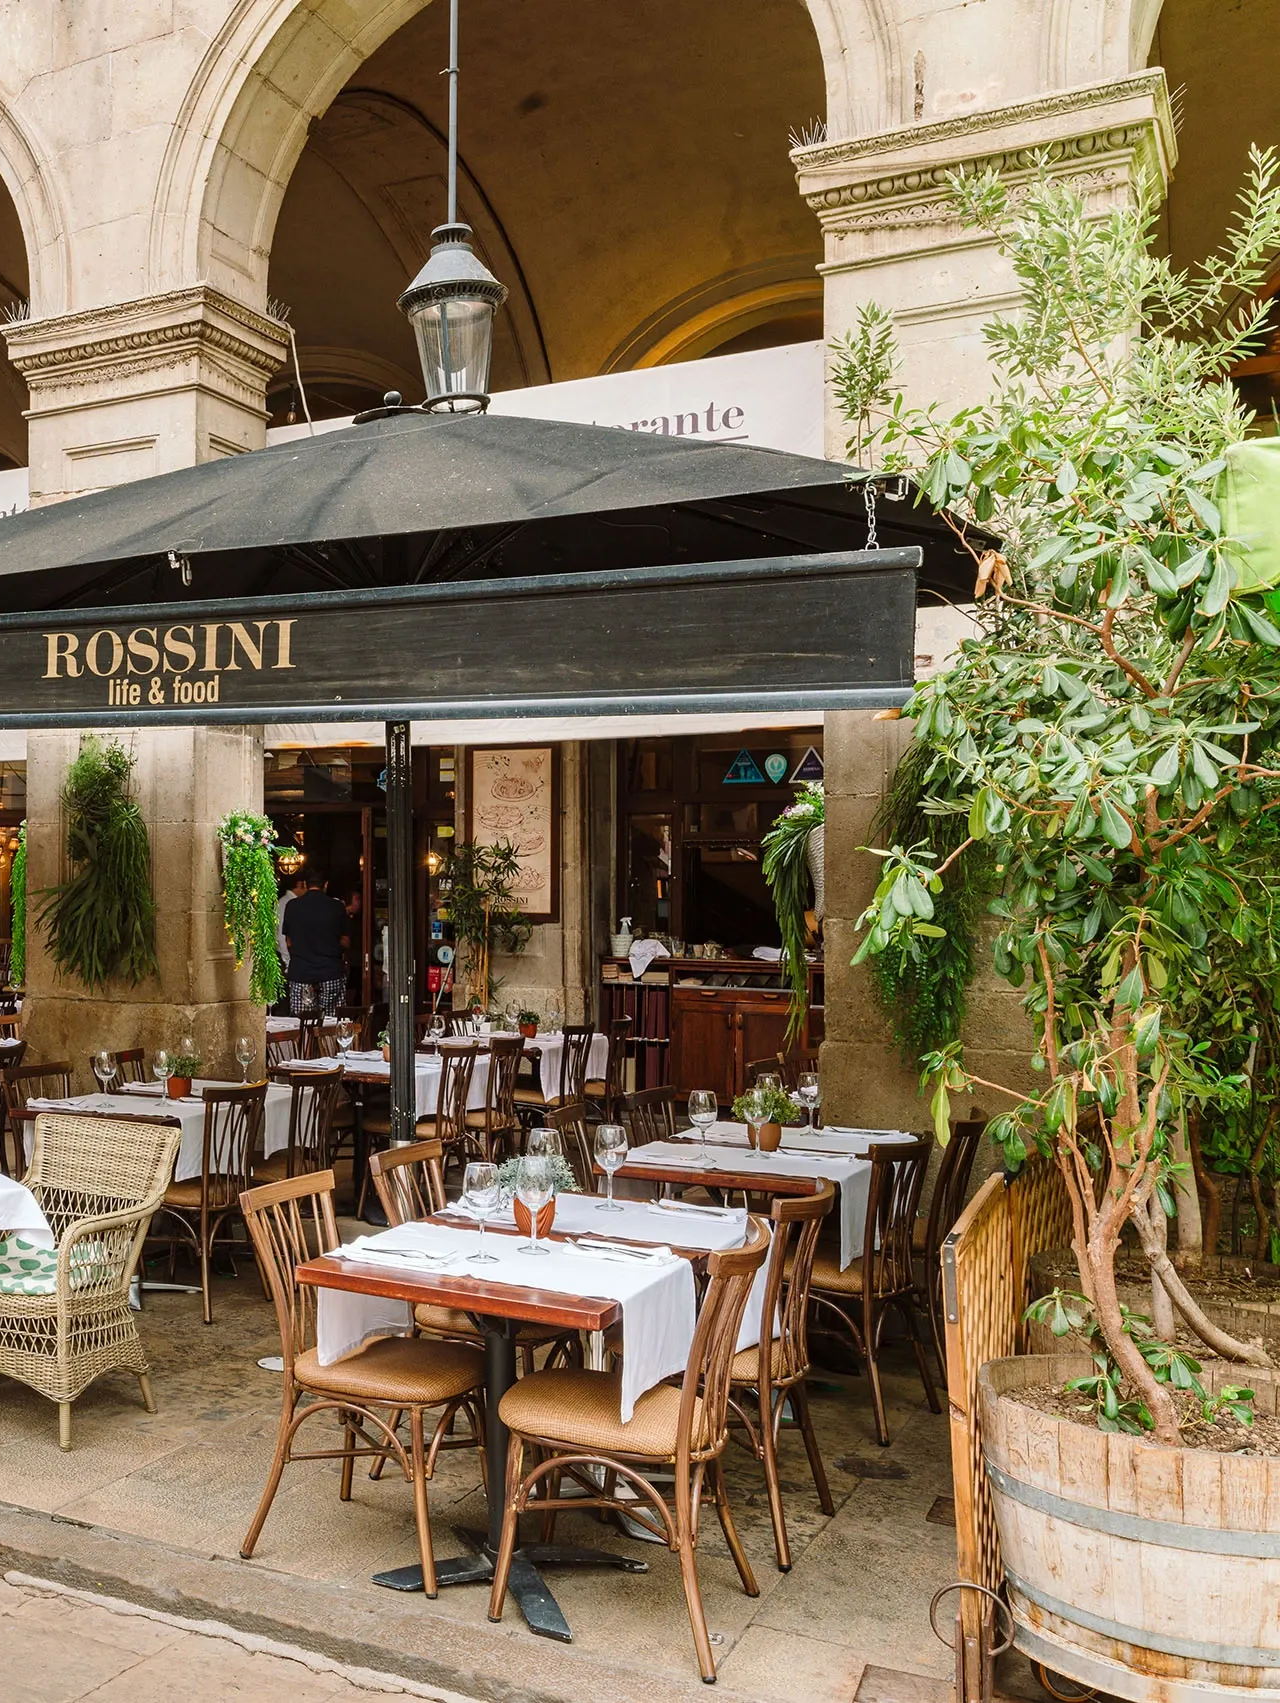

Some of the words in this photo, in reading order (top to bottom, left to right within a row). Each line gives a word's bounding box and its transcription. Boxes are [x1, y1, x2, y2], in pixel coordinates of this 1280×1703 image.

[41, 619, 299, 679] ROSSINI
[108, 679, 141, 706] life
[148, 677, 165, 704] &
[173, 675, 220, 703] food
